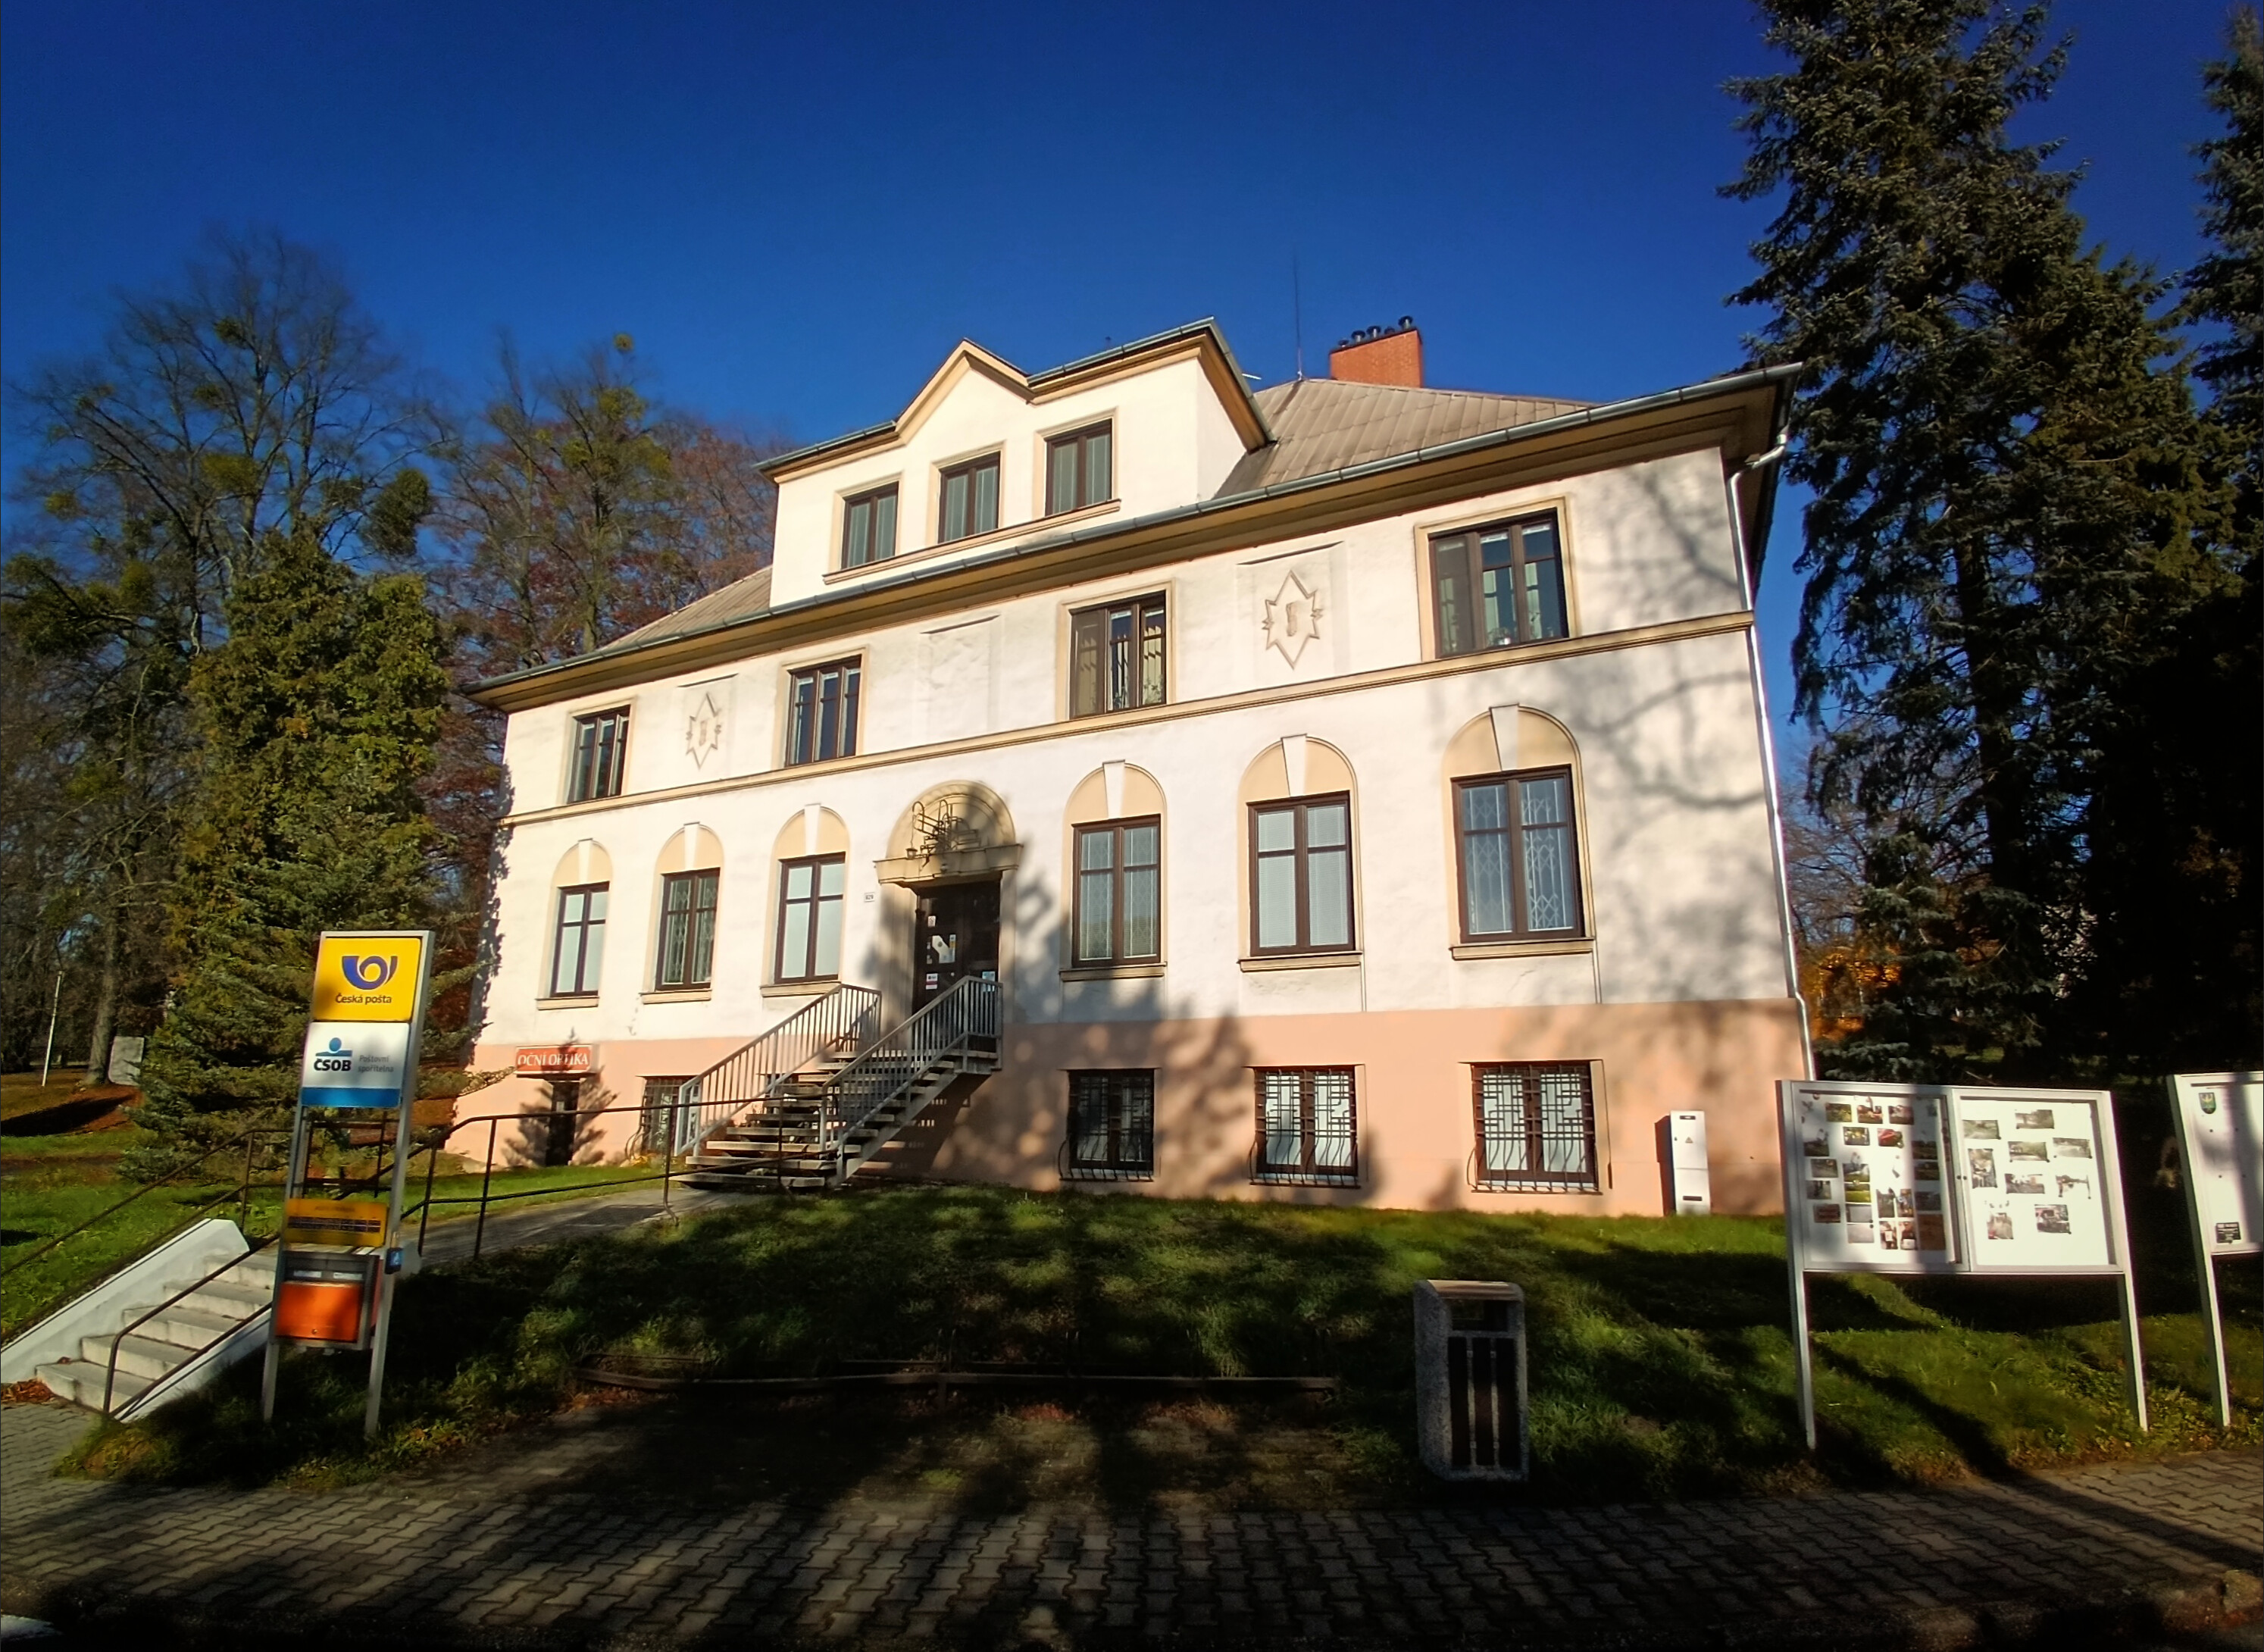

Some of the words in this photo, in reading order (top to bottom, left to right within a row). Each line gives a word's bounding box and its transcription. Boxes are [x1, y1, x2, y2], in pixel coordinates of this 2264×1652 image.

[336, 993, 363, 1003] Česká
[365, 995, 392, 1005] pošta
[359, 1054, 389, 1063] Poštovní
[518, 1052, 546, 1065] OČNÍ
[314, 1058, 352, 1072] ČSOB
[358, 1065, 394, 1074] spořitelna
